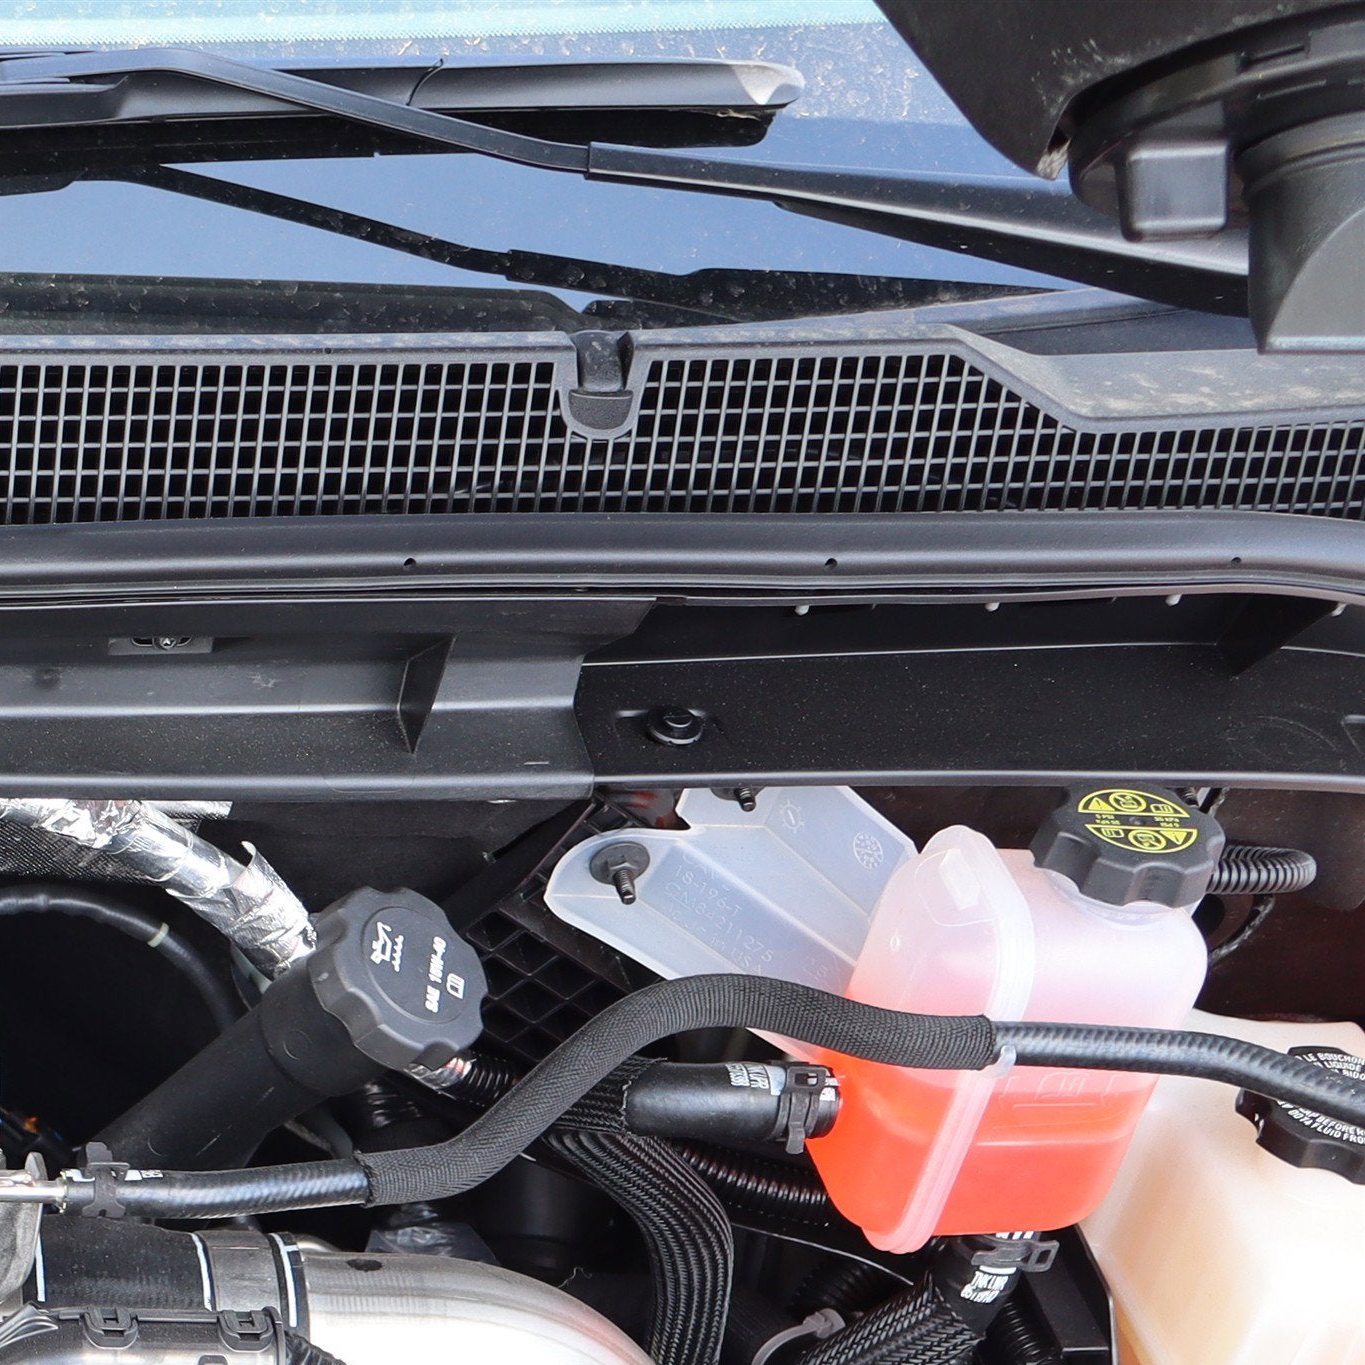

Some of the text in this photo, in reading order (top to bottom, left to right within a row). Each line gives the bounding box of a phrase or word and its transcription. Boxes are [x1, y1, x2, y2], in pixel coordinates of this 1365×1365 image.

[425, 984, 441, 1013] SAE
[1323, 1060, 1362, 1072] LIQUIDE
[1310, 1120, 1342, 1139] FLUID
